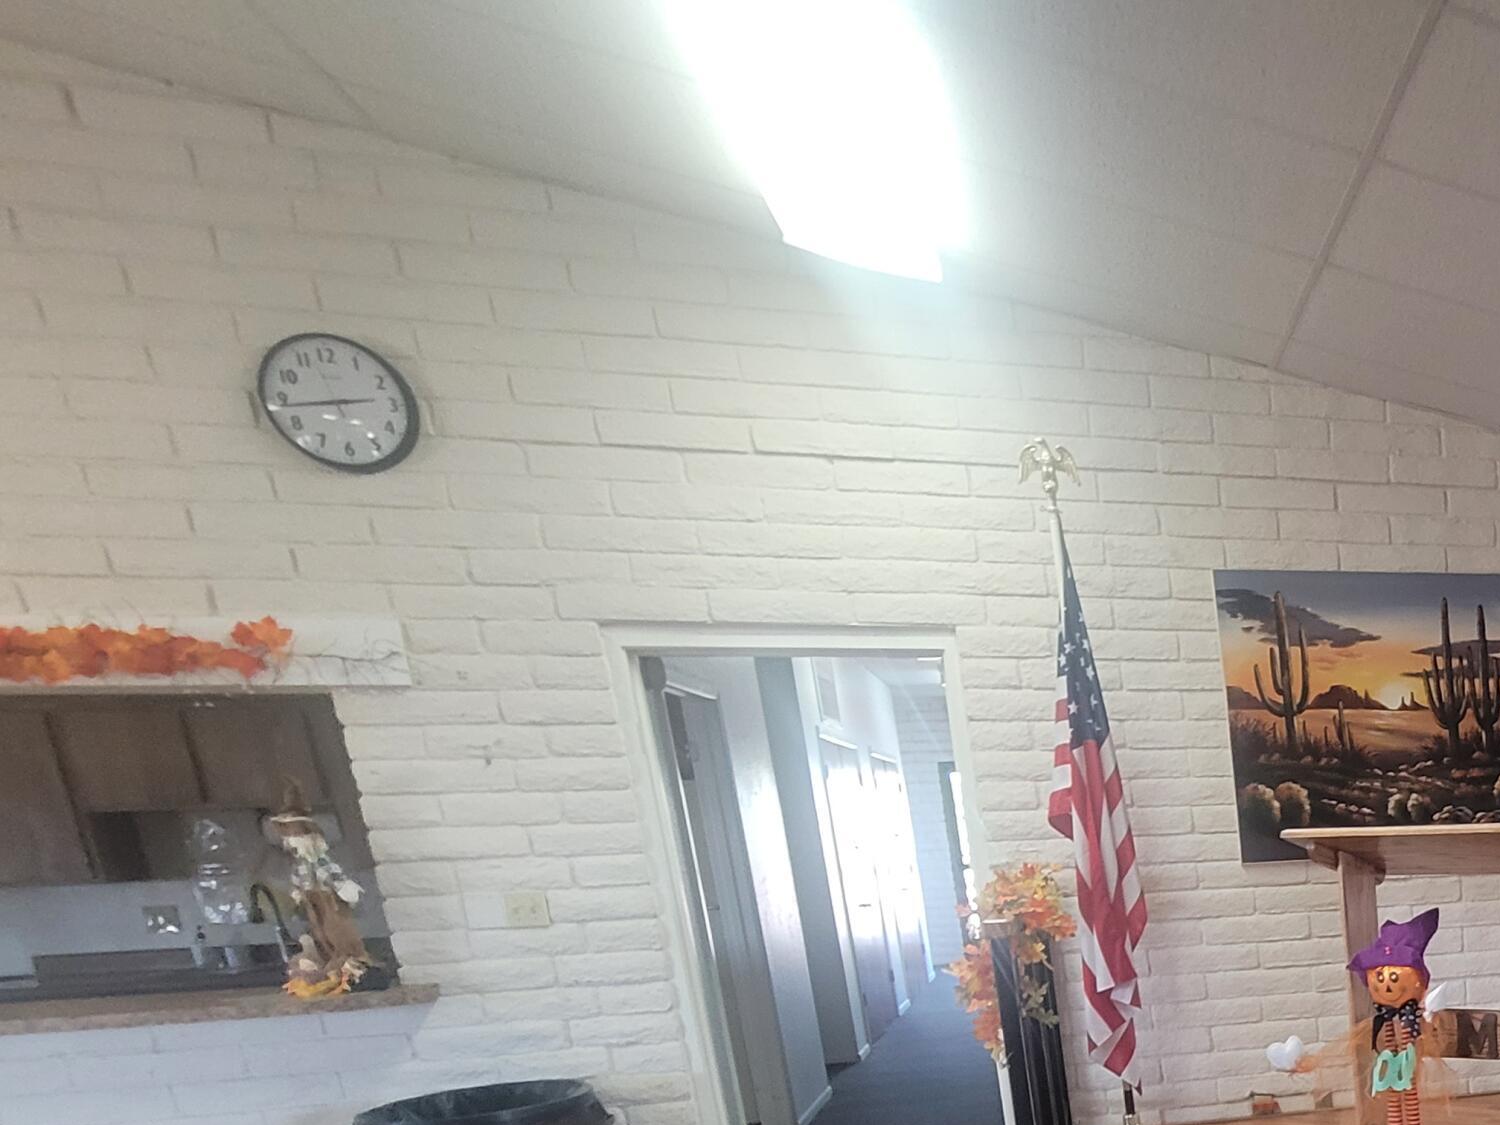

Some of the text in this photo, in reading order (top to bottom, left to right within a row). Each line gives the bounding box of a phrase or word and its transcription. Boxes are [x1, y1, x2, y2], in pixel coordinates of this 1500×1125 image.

[296, 352, 311, 368] 11
[316, 348, 337, 364] 12
[352, 356, 360, 371] 1
[279, 368, 298, 384] 10
[374, 375, 386, 390] 2
[276, 391, 288, 405] 9
[387, 397, 399, 413] 3
[290, 415, 303, 431] 8
[384, 420, 396, 435] 4
[315, 432, 326, 448] 7
[344, 441, 356, 457] 6
[1456, 1012, 1498, 1059] M
